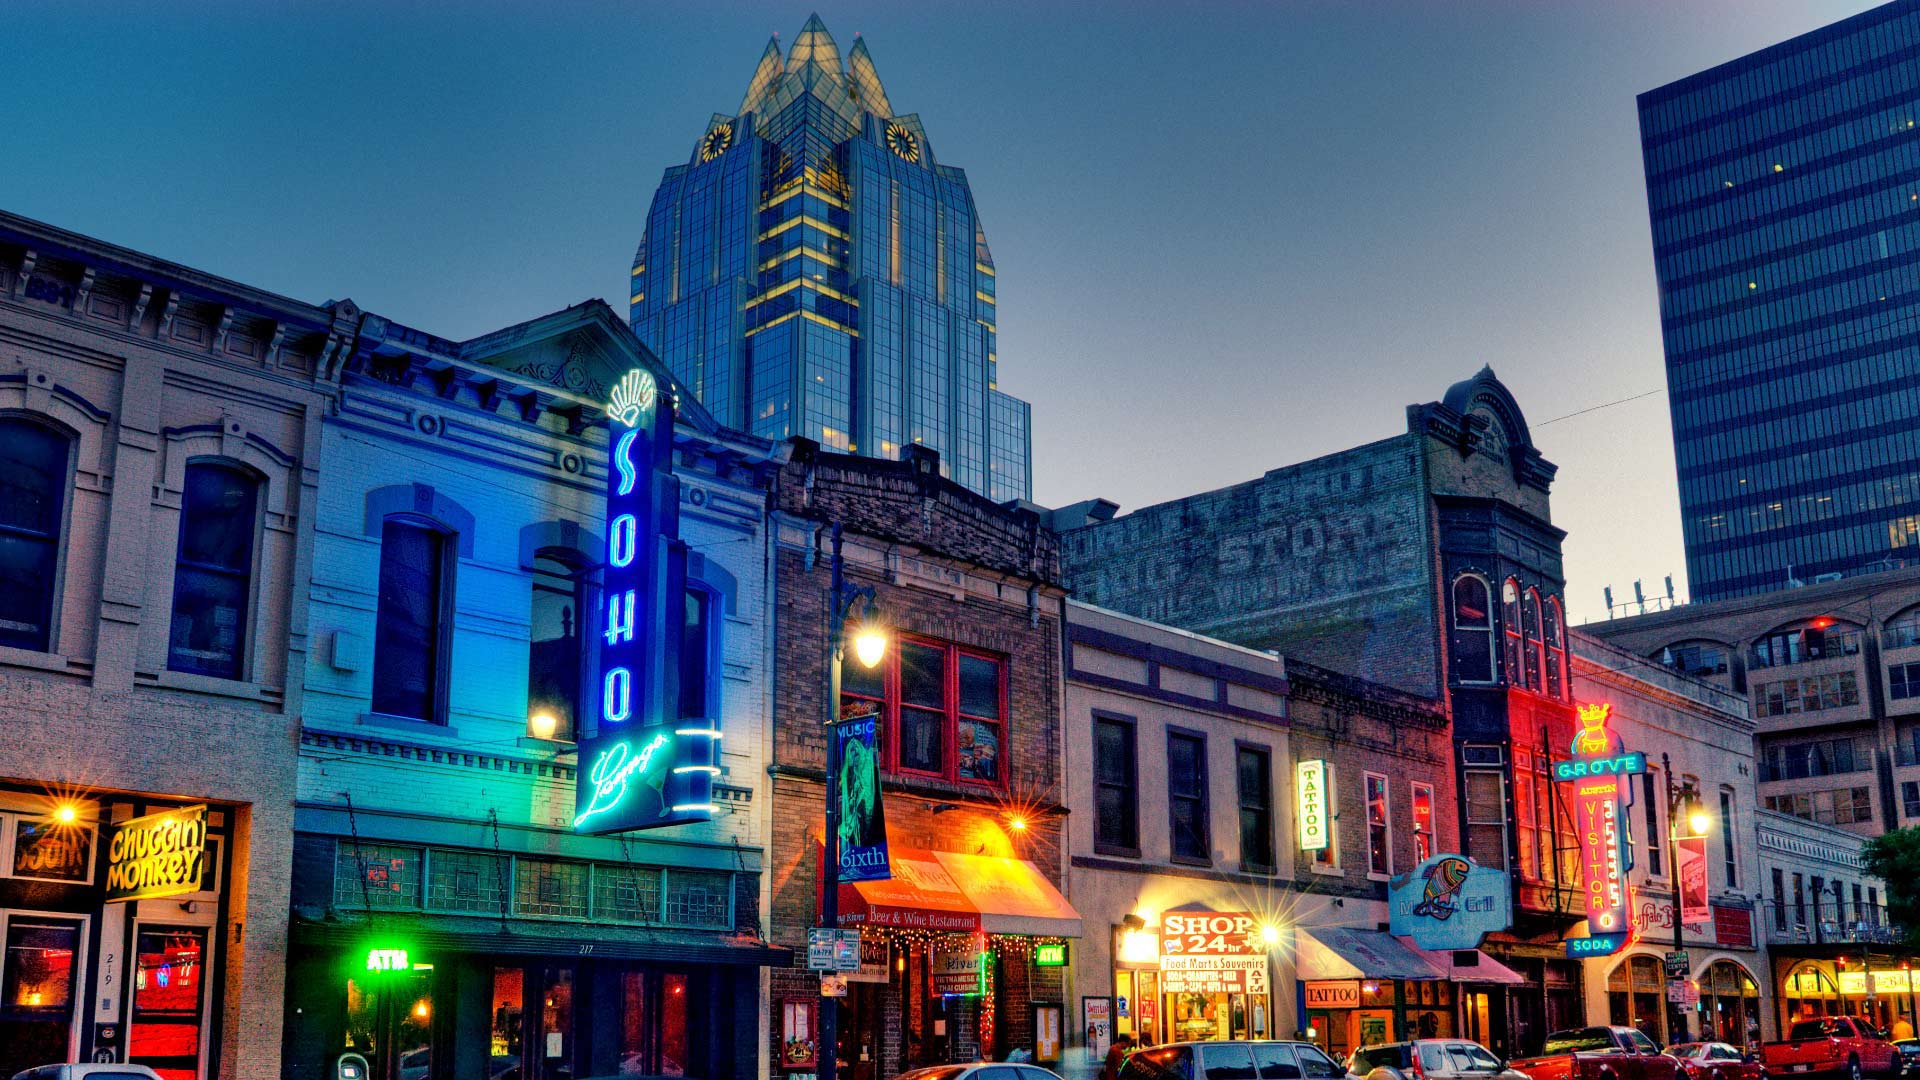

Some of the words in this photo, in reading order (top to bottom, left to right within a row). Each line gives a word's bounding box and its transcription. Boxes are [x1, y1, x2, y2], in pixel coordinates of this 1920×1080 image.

[604, 427, 640, 722] SOHO
[837, 721, 876, 738] MUSIC
[1559, 757, 1637, 778] GROVE
[573, 734, 670, 827] Lounge
[1580, 784, 1616, 795] AUSTIN
[1304, 770, 1318, 836] TATTOO
[841, 847, 886, 868] 6ixth
[1586, 801, 1604, 910] VISITOR
[1466, 895, 1495, 912] Grill
[870, 904, 890, 922] Beer
[893, 912, 900, 923] &
[904, 912, 926, 925] Wine
[929, 915, 975, 928] Restaurant
[1165, 915, 1253, 935] SHOP
[579, 944, 594, 954] 217
[1187, 935, 1241, 952] 24hr
[1573, 939, 1612, 952] SODA
[367, 949, 409, 970] ATM
[1038, 947, 1064, 962] ATM
[1166, 958, 1186, 968] Food
[1189, 958, 1211, 968] Mart
[1220, 958, 1264, 969] Souvenirs
[105, 953, 113, 985] 219
[936, 975, 975, 983] VIETNAMESE
[954, 983, 979, 991] CUISINE
[1250, 970, 1264, 992] ATM
[1308, 988, 1357, 1001] TATTOO
